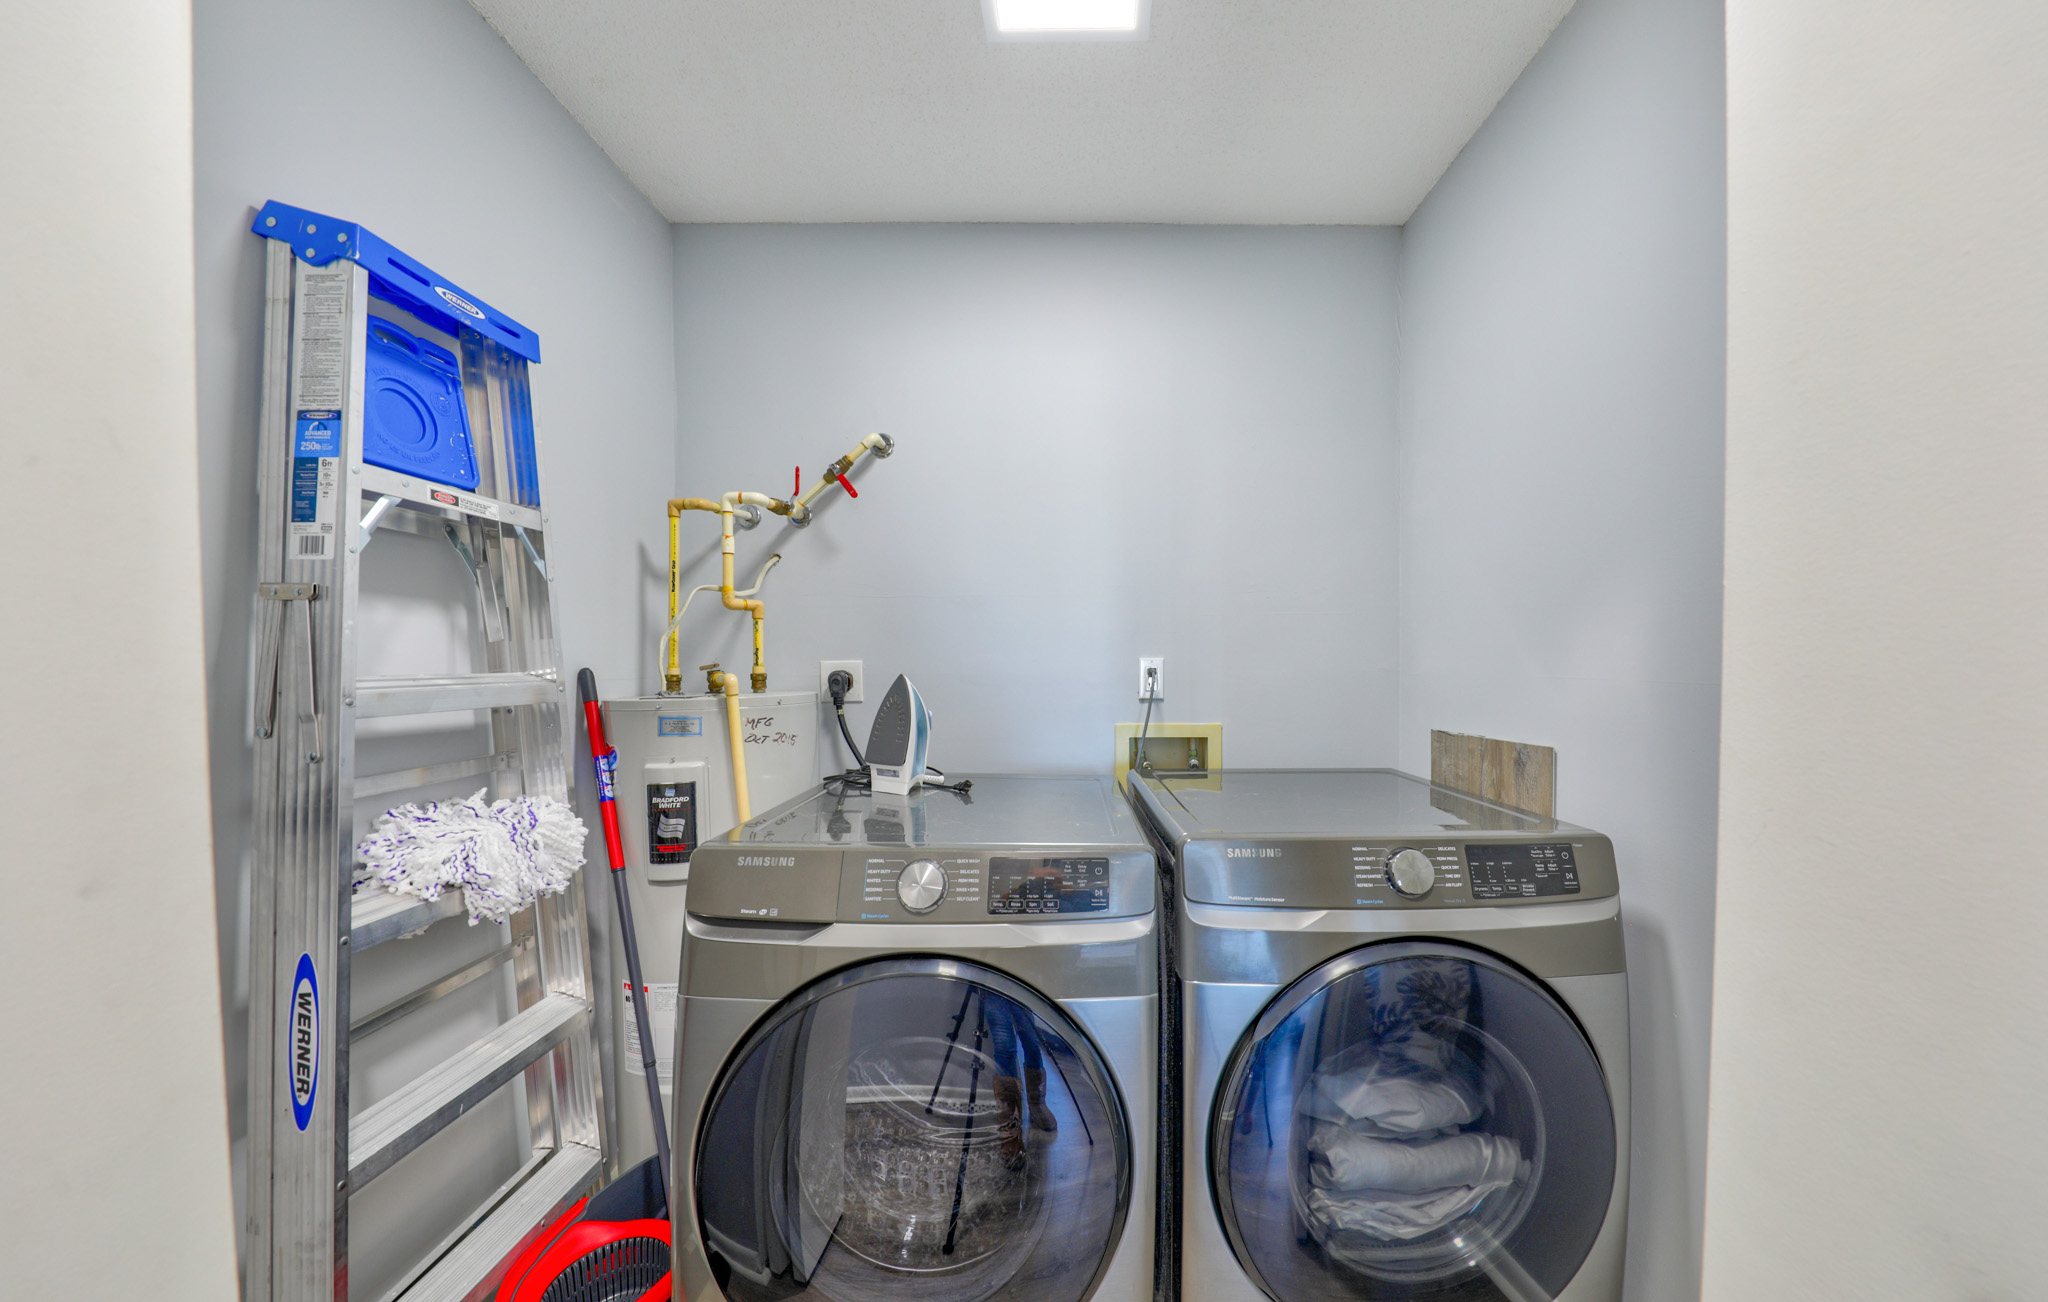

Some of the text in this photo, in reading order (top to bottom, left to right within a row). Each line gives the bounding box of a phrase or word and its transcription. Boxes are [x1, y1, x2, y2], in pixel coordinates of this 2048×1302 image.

[445, 292, 477, 315] WERNER
[744, 717, 774, 730] MFG
[772, 732, 798, 746] 2015
[652, 796, 690, 804] BRADFORD
[1227, 848, 1282, 858] SAMSUNG
[737, 856, 796, 867] SAMSUNG
[296, 992, 312, 1097] WERNER
